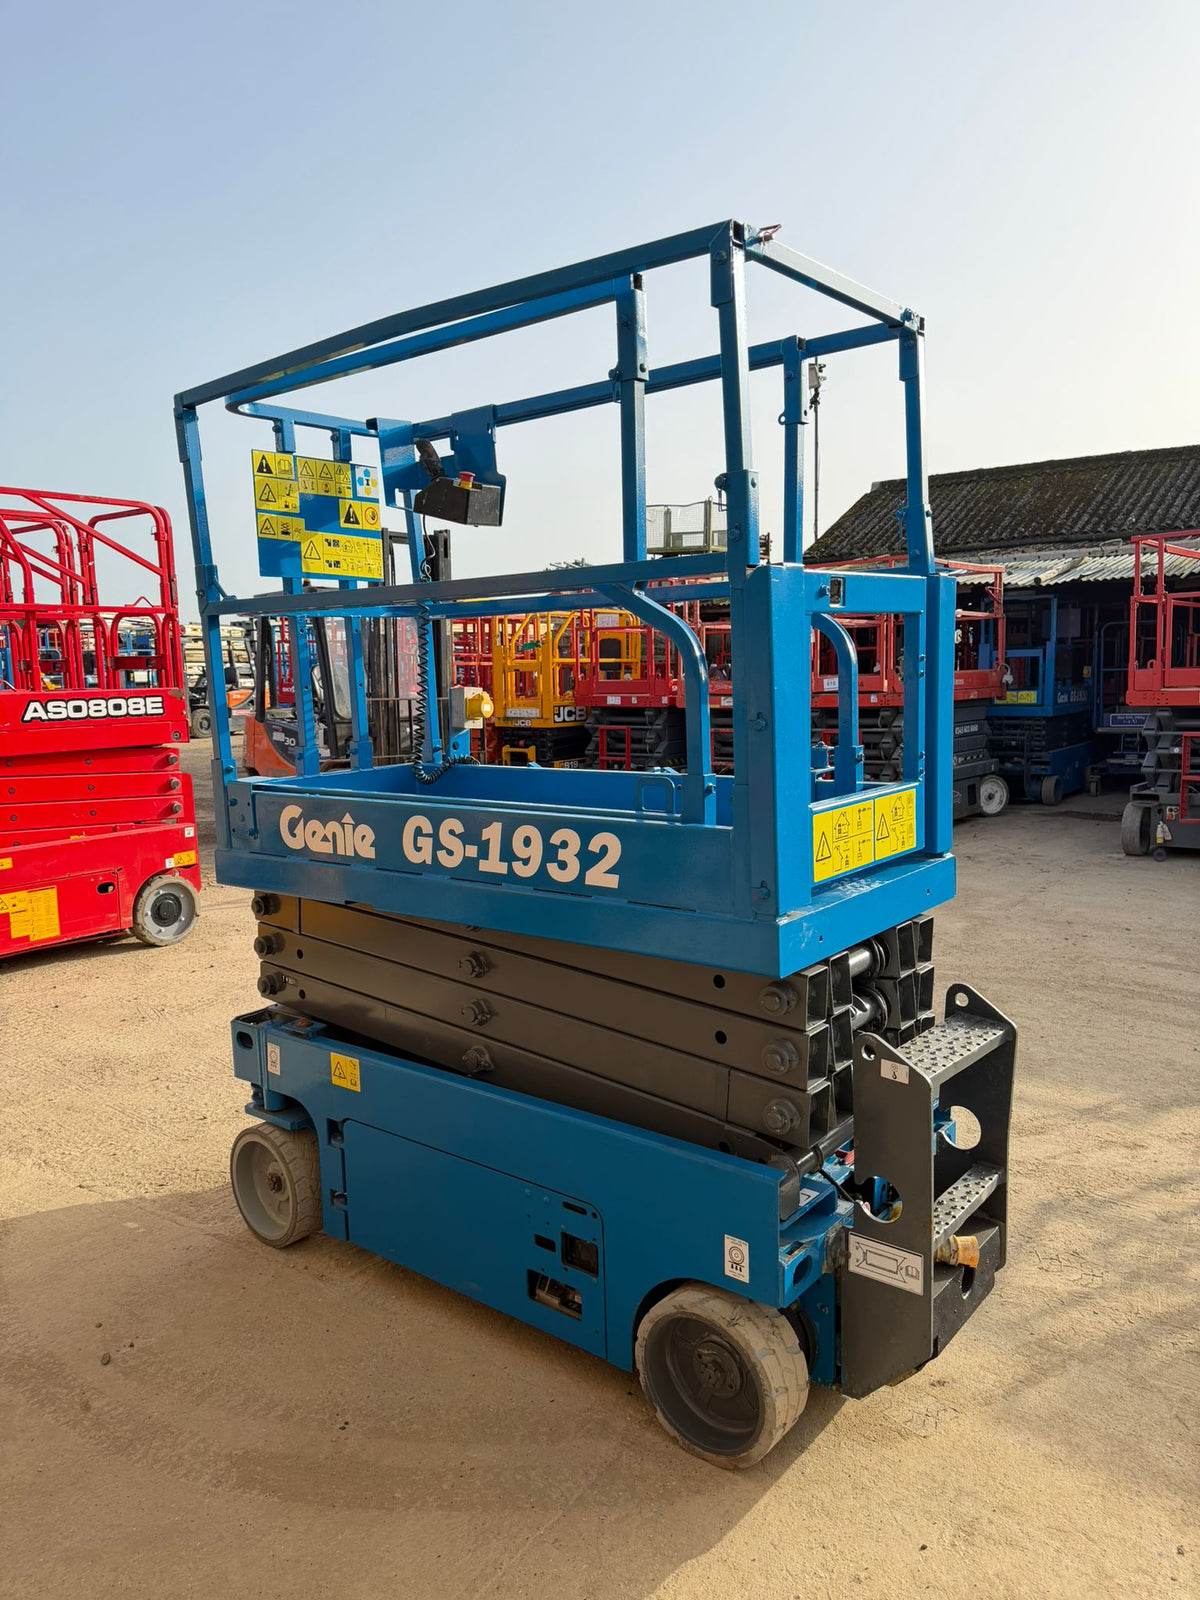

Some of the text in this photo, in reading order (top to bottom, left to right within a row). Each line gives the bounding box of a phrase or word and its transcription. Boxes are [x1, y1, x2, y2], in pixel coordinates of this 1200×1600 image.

[22, 696, 165, 722] AS0808E
[554, 706, 587, 722] JCB
[515, 719, 531, 727] JCB
[284, 737, 296, 746] 30
[279, 804, 622, 889] Genie GS-1932
